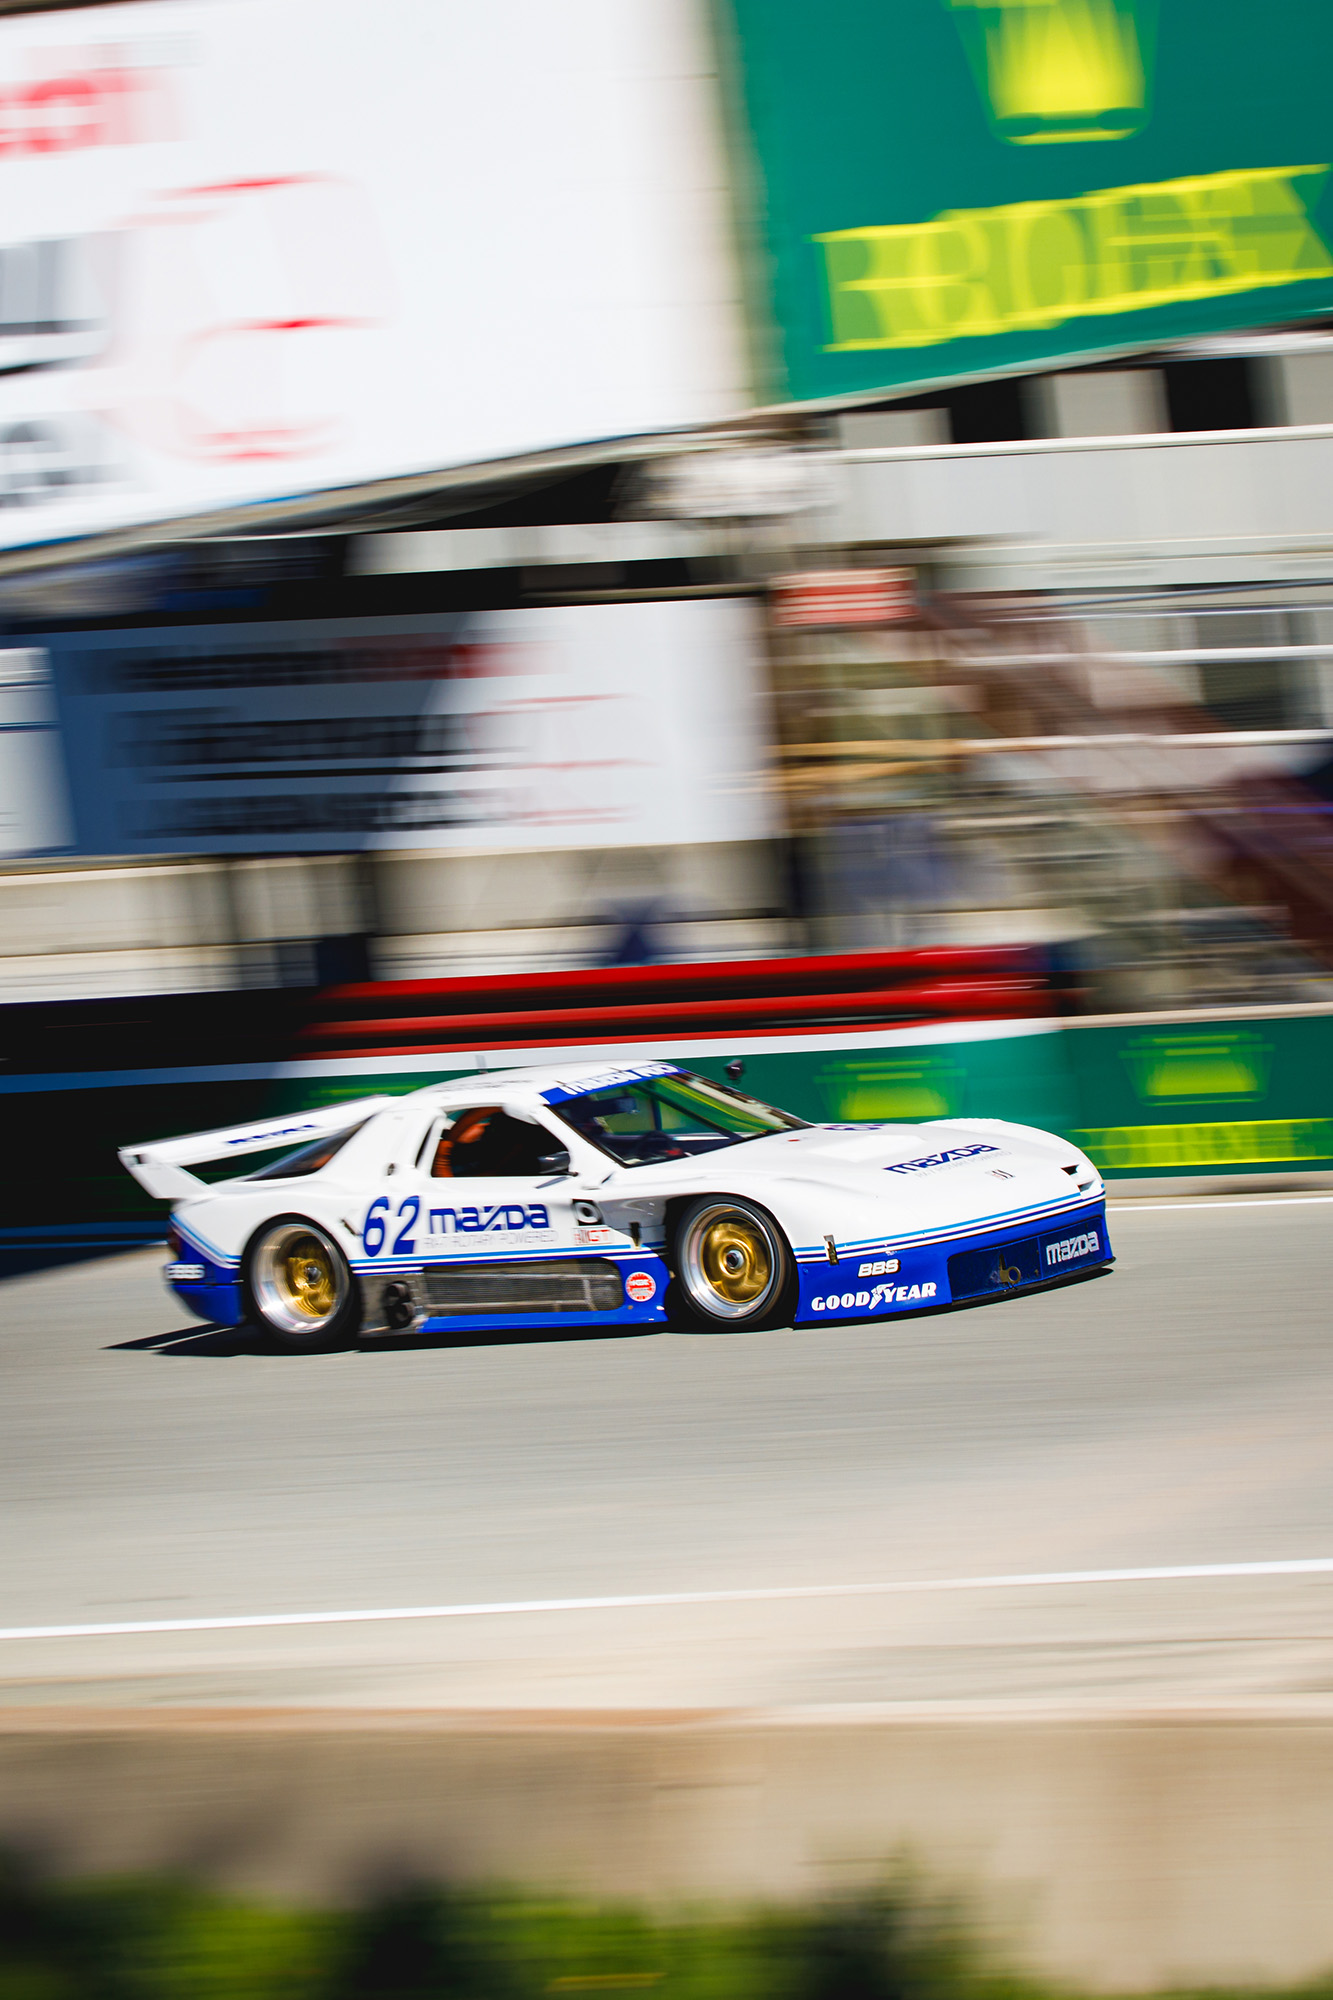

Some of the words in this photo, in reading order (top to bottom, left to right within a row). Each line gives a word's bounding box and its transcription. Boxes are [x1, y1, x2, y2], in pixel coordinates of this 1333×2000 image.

[882, 1143, 1001, 1174] mazda
[363, 1195, 420, 1257] 62
[429, 1203, 550, 1234] mazda
[1046, 1231, 1100, 1265] mazda
[858, 1259, 900, 1277] BBS
[811, 1282, 937, 1311] GOODYEAR
